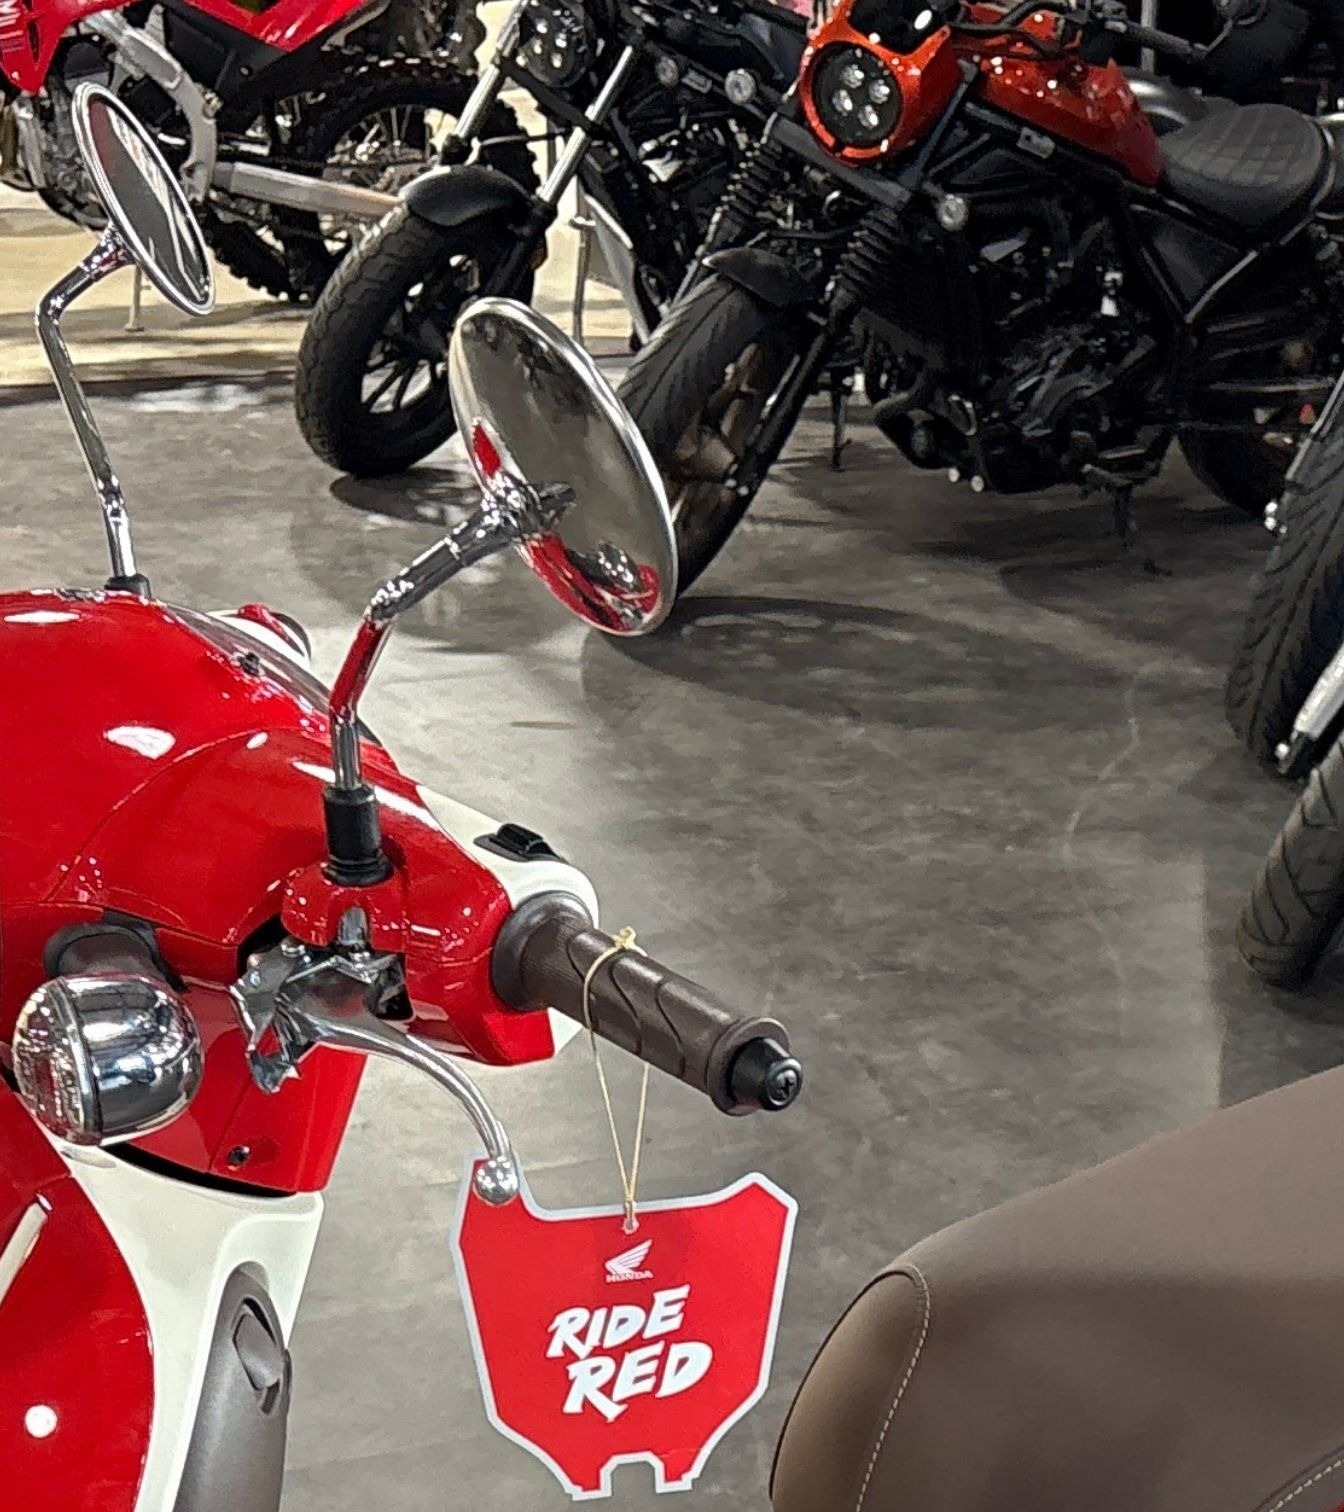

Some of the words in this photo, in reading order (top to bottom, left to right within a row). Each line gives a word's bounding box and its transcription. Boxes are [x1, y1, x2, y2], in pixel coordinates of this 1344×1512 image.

[606, 1270, 654, 1283] HONDA
[545, 1283, 692, 1361] RIDE
[562, 1340, 714, 1423] RED
